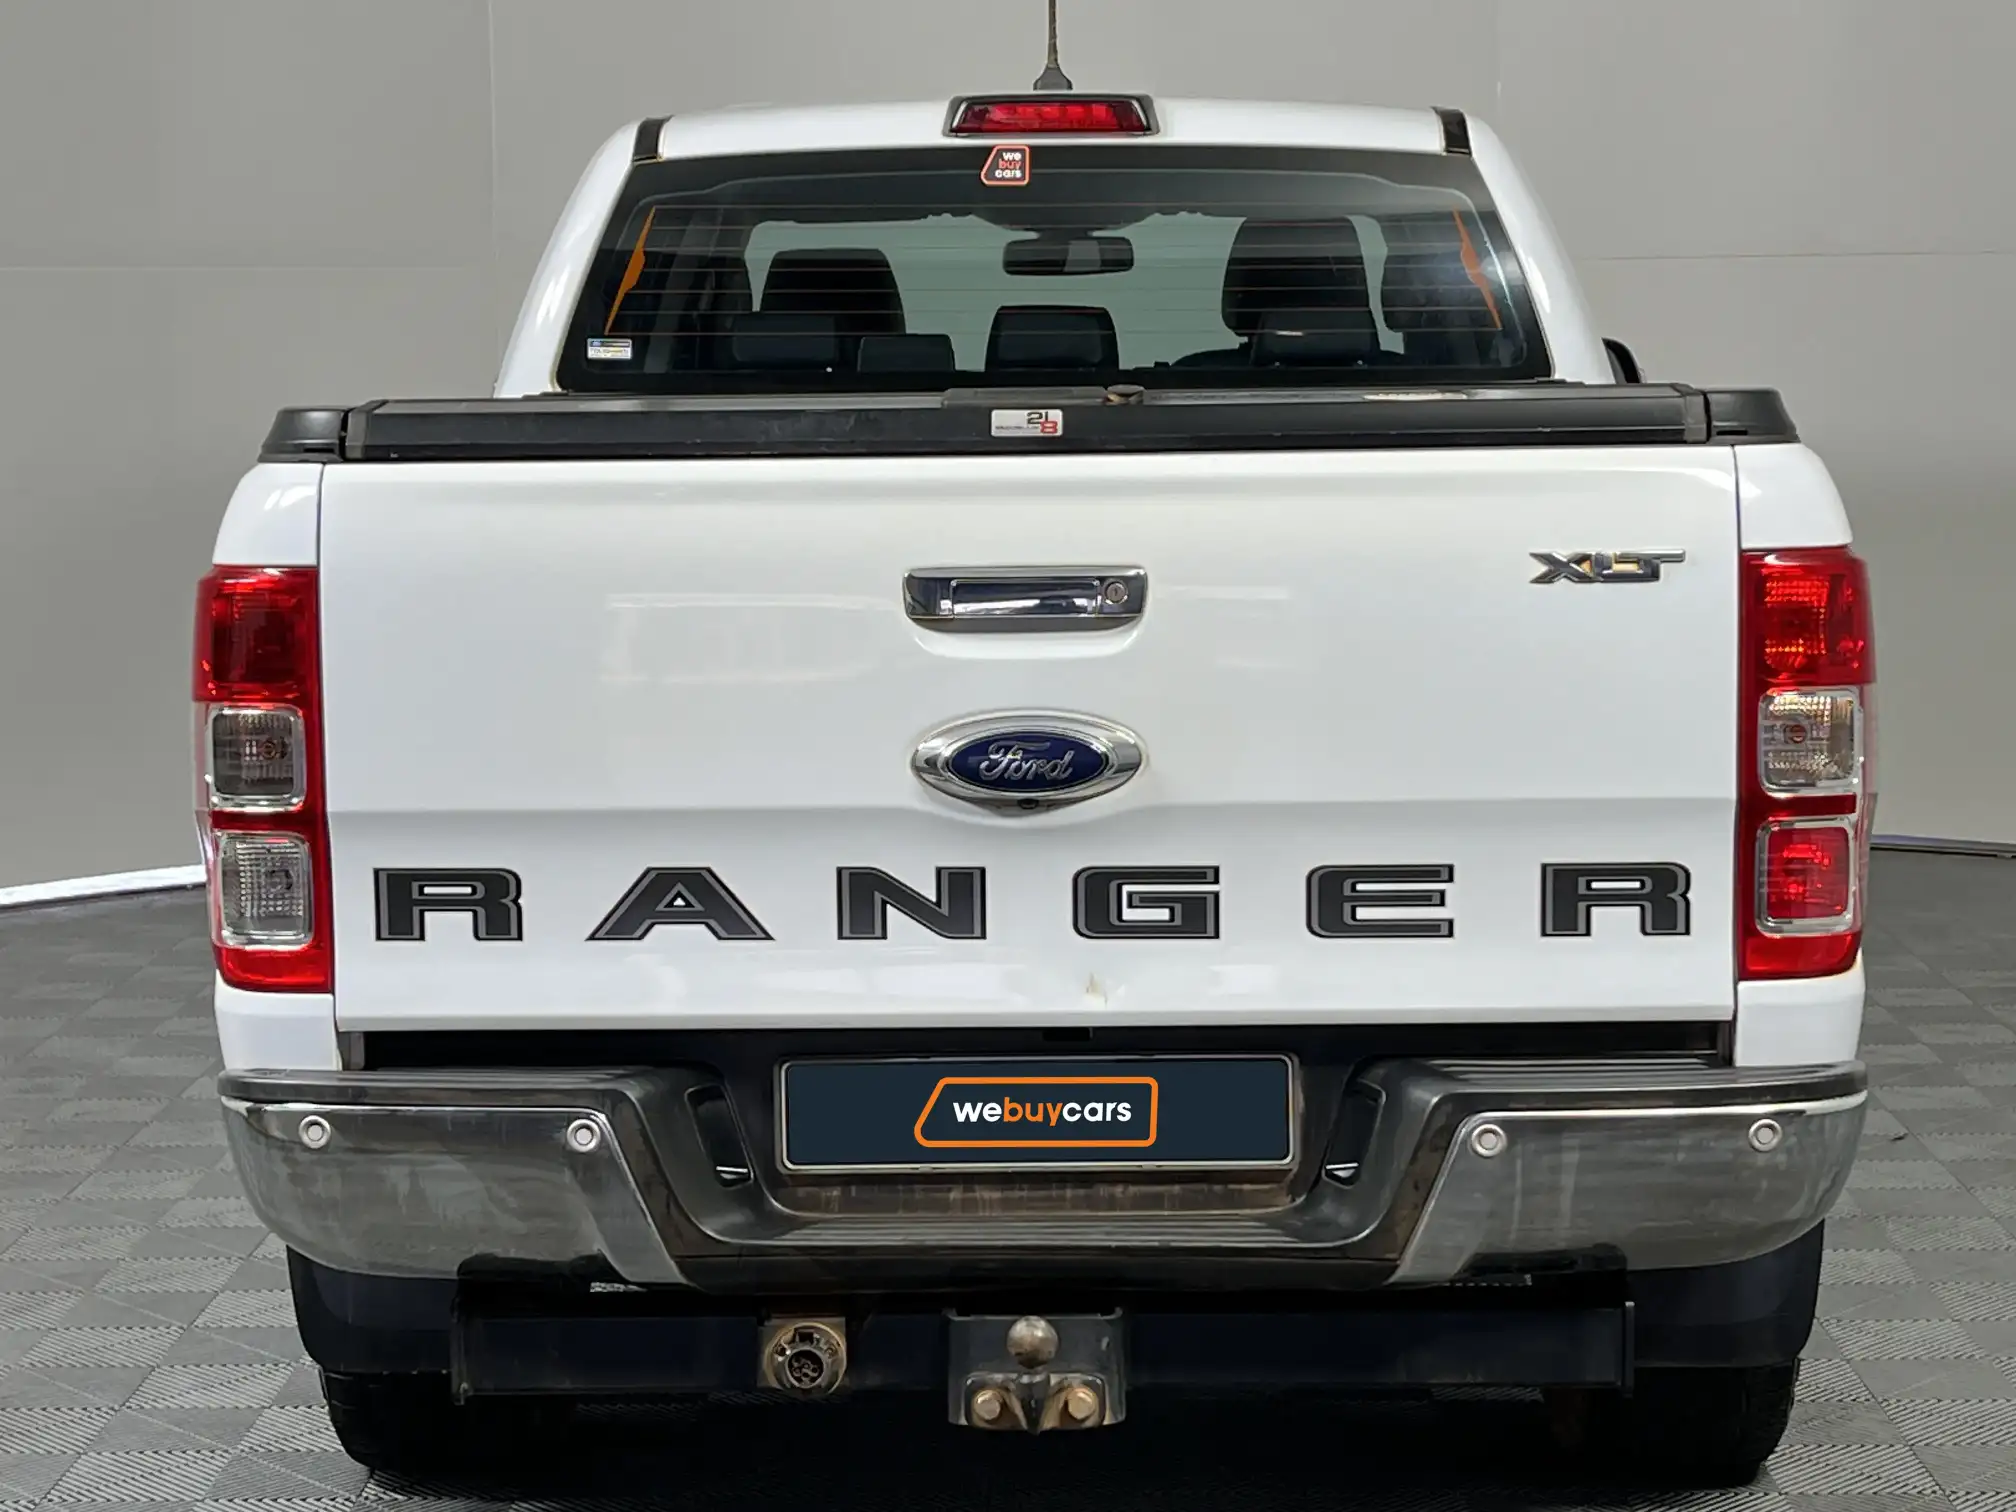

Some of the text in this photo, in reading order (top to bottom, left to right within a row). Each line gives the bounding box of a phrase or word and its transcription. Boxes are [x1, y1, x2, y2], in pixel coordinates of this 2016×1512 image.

[1528, 549, 1686, 583] XLT
[979, 741, 1075, 781] Ford
[373, 863, 1692, 942] RANGER
